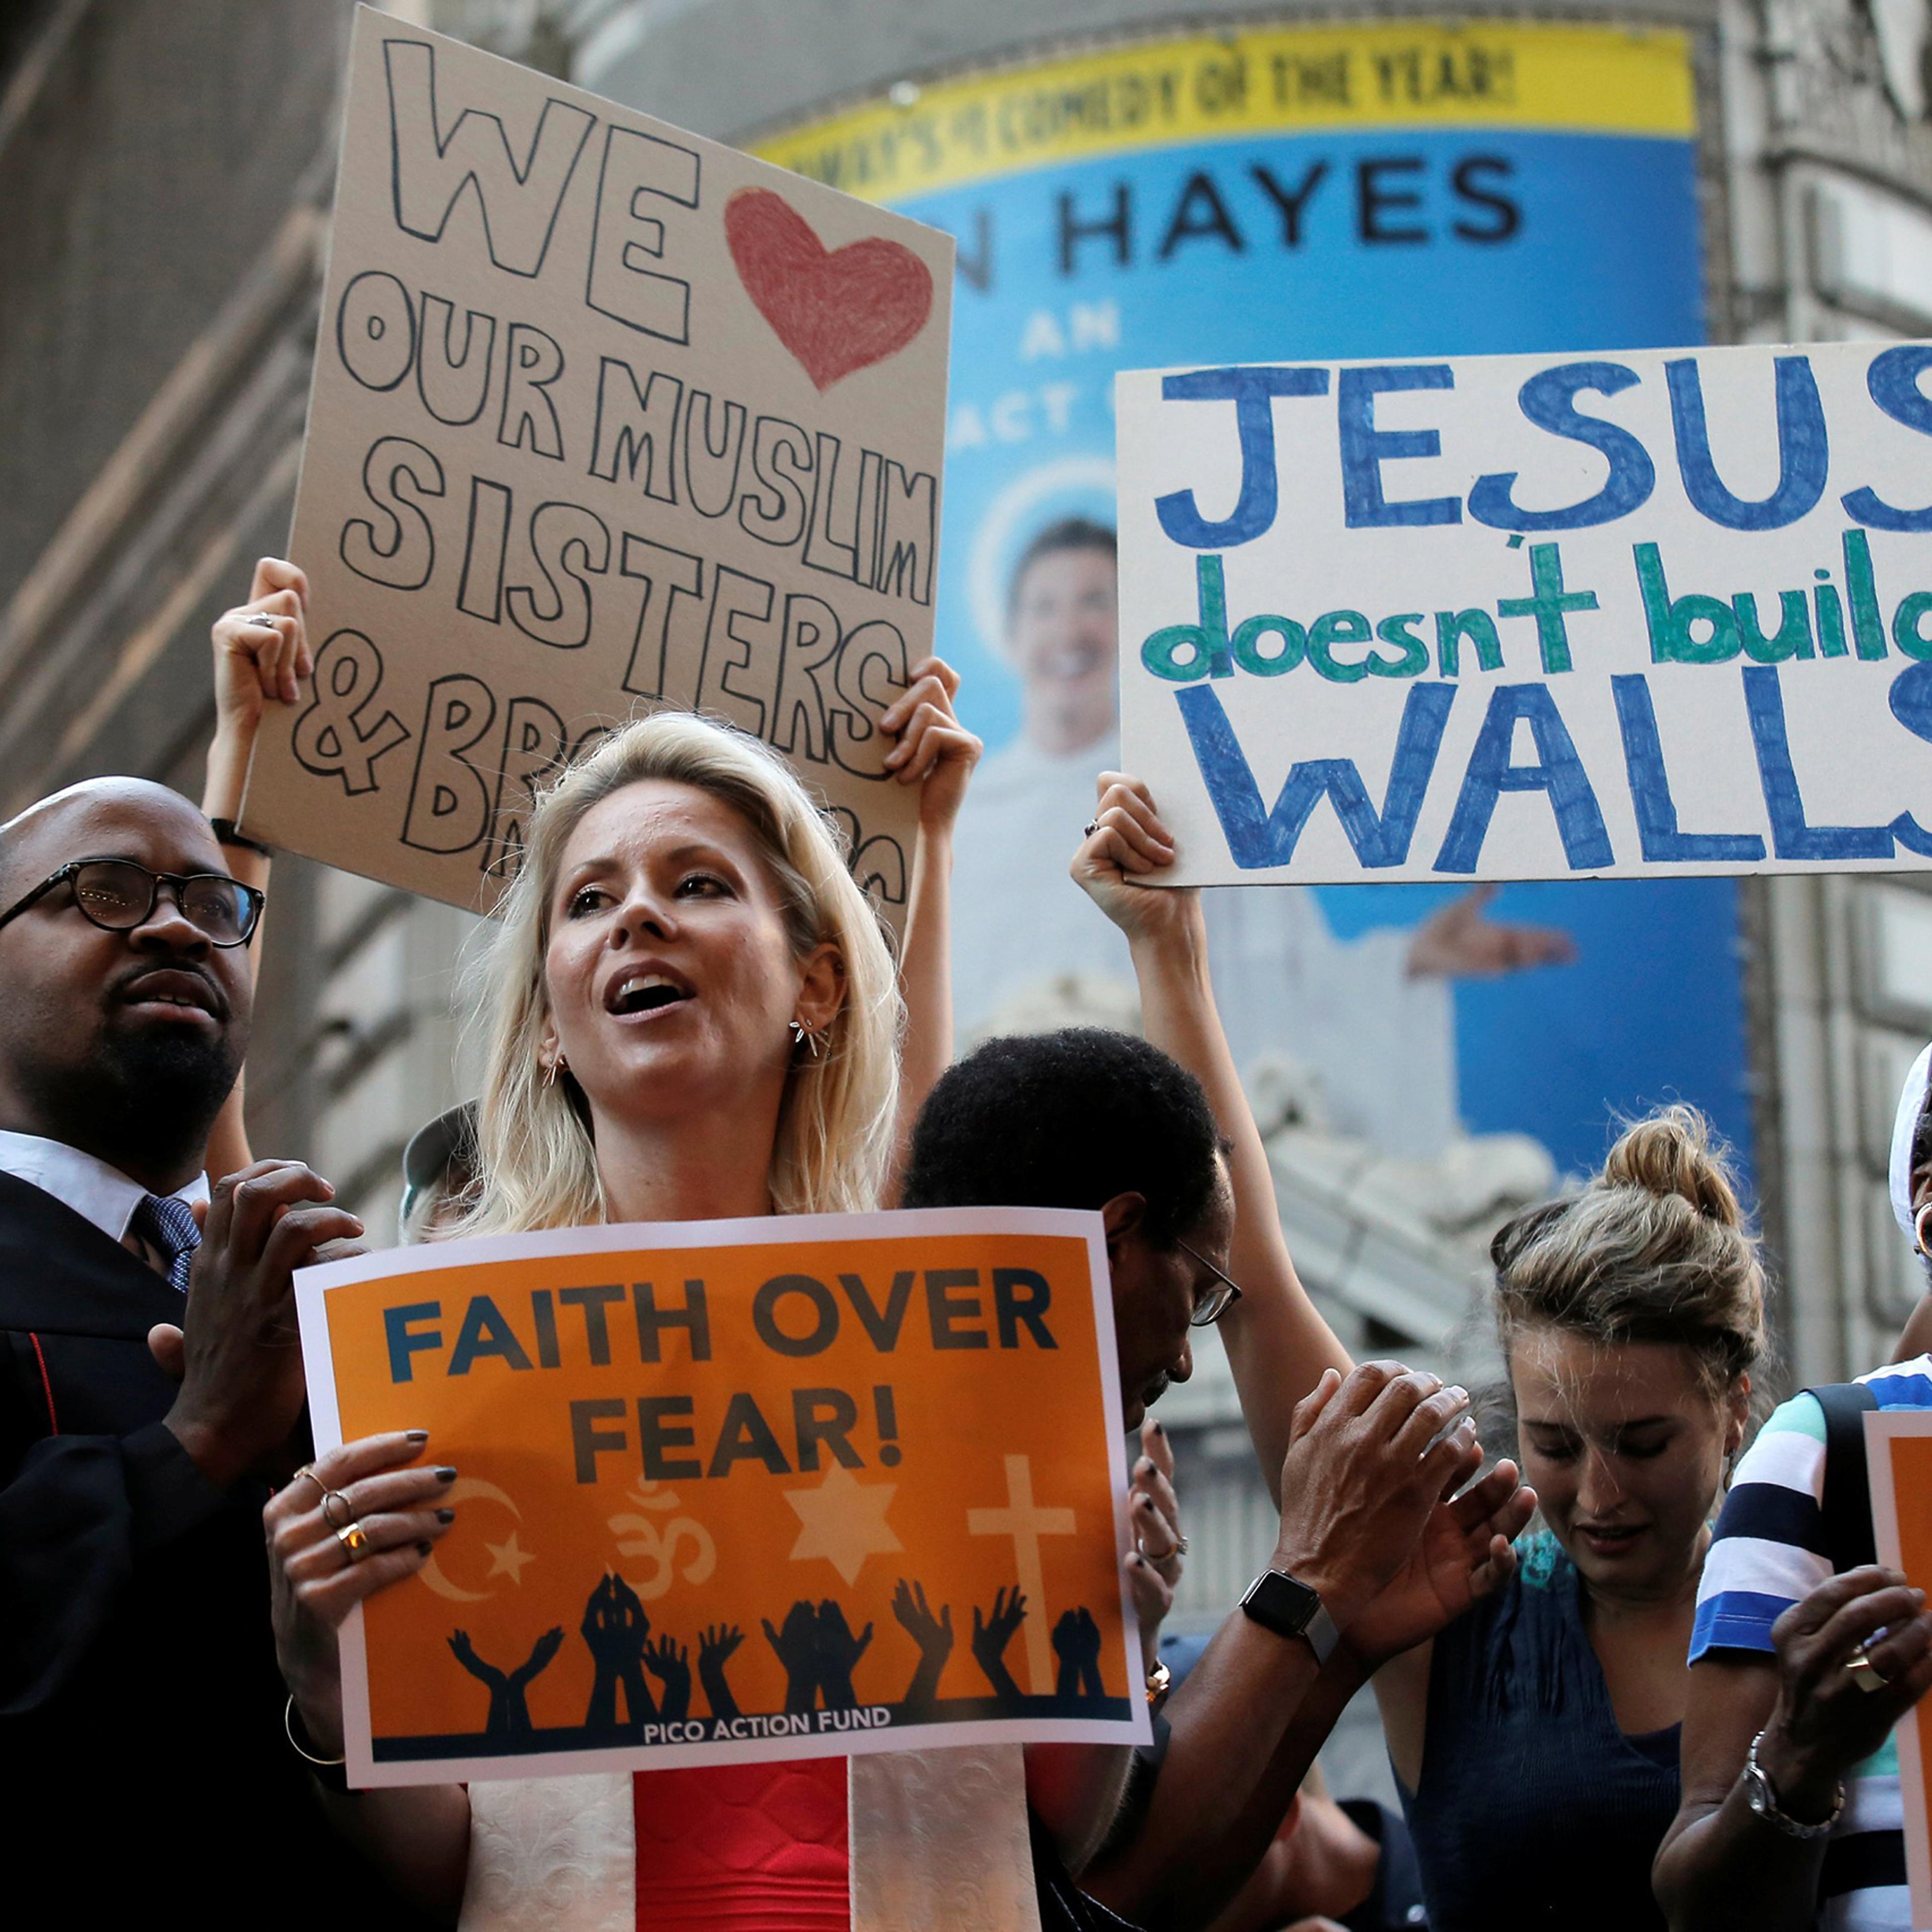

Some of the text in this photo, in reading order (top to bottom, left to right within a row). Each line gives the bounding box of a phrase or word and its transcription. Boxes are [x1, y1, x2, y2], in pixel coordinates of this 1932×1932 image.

[998, 64, 1181, 150] COMEDY
[1194, 51, 1249, 116] OF
[1270, 48, 1351, 108] THE
[384, 39, 700, 346] WE
[1058, 153, 1522, 278] HAYES
[1018, 302, 1121, 363] AN
[337, 271, 936, 605] OUR MUSLIM
[948, 380, 1078, 450] ACT
[340, 437, 907, 781] SISTERS
[383, 1267, 1059, 1384] FAITH OVER
[569, 1384, 903, 1485] FEAR!
[643, 1707, 892, 1744] PICO ACTION FUND
